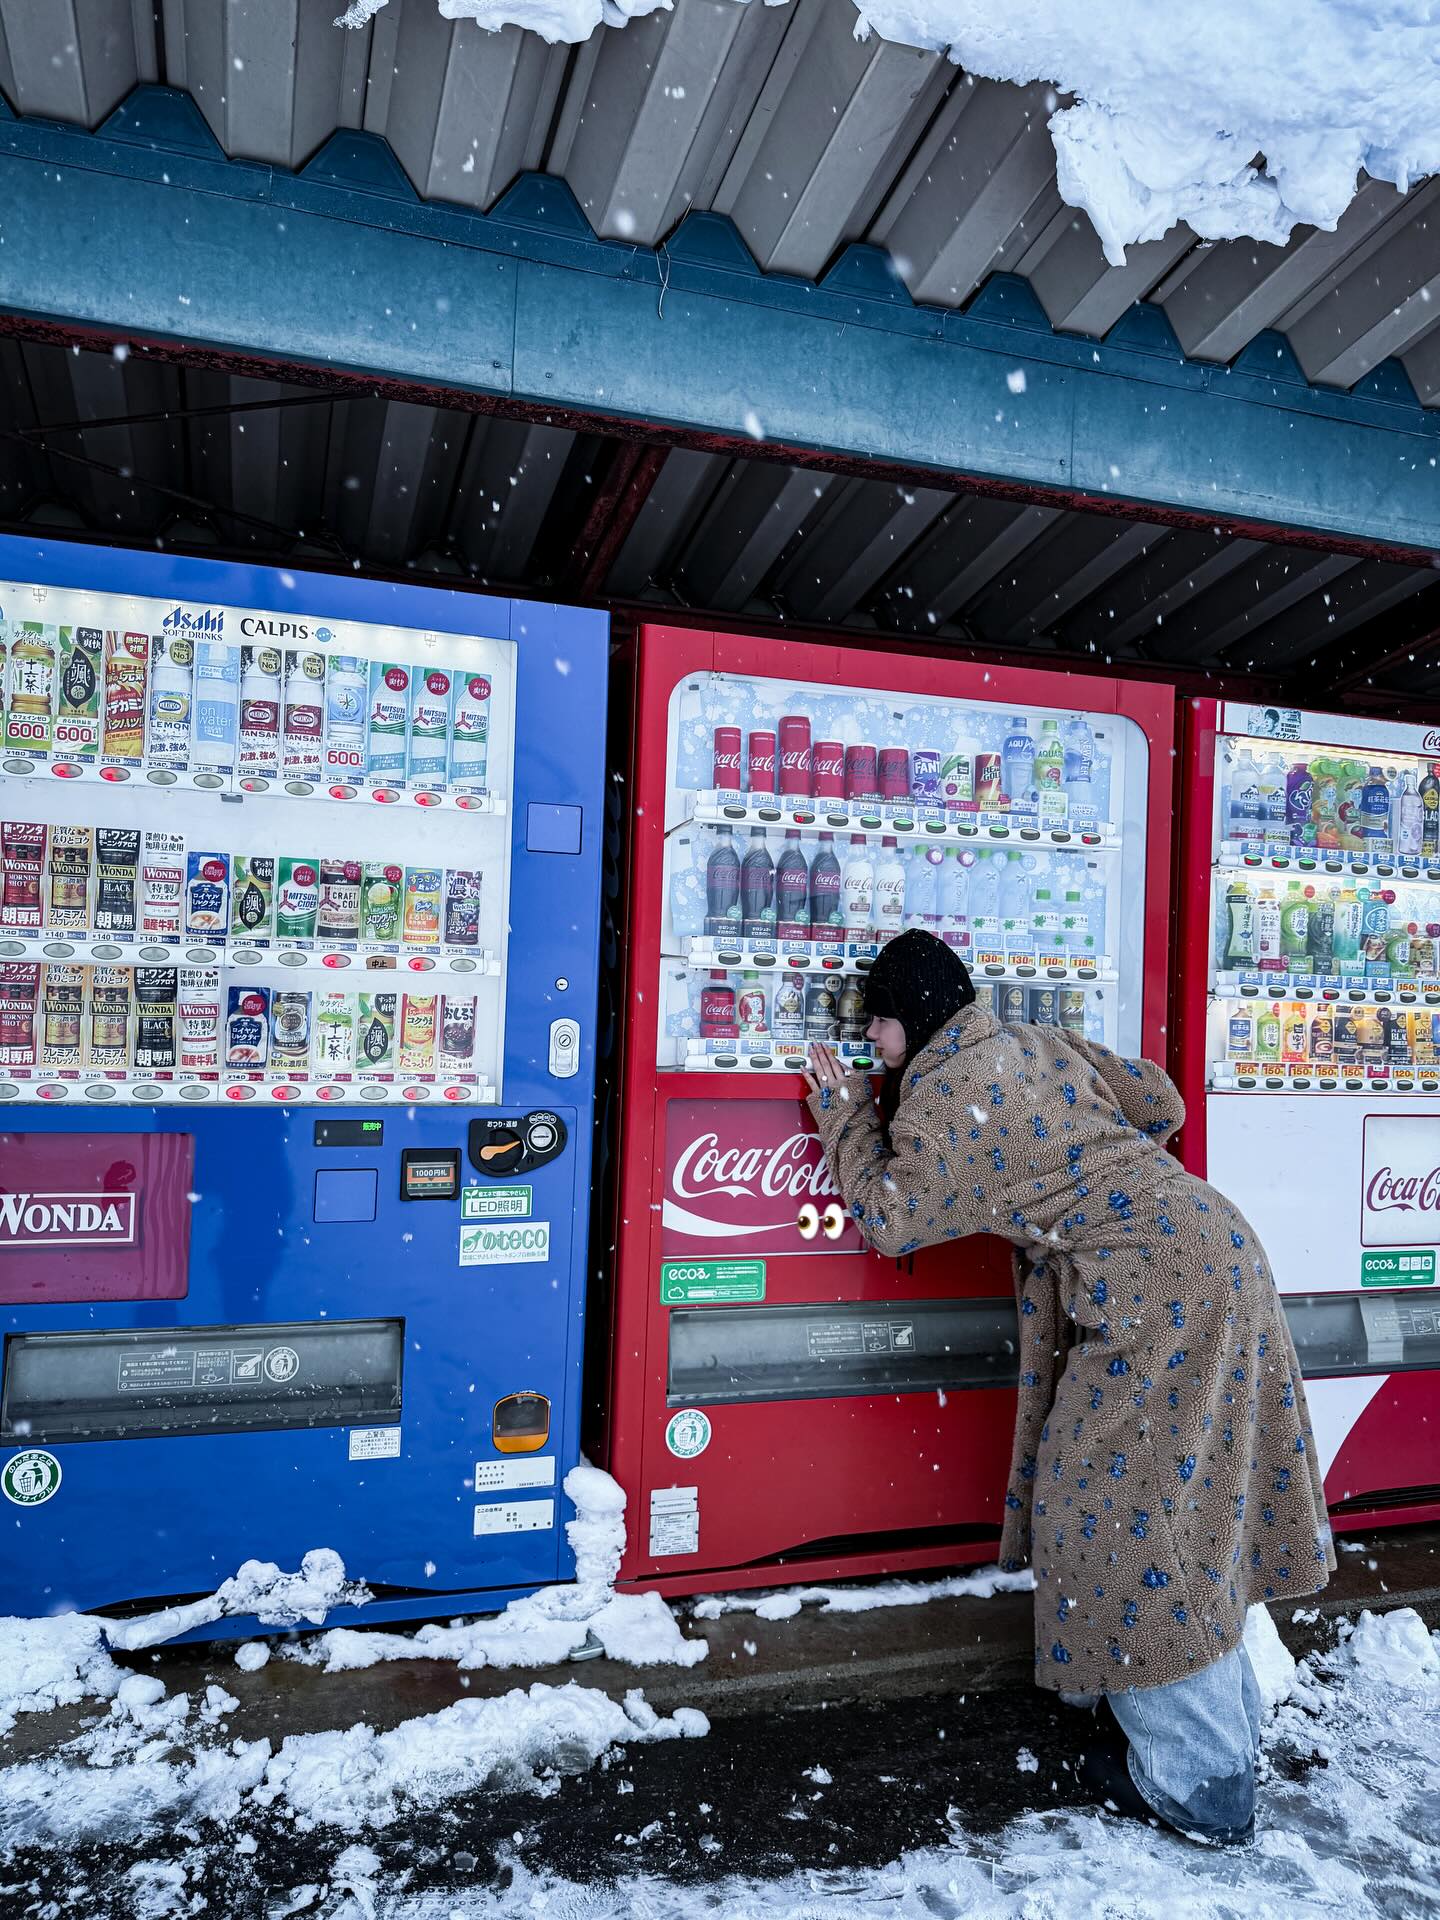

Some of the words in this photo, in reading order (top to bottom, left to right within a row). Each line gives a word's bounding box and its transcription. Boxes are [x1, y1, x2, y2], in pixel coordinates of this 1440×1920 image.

[162, 607, 224, 633] Asahi
[240, 618, 308, 639] CALPIS
[80, 630, 102, 640] すっきり
[162, 629, 187, 637] SOFT
[188, 631, 223, 642] DRINKS
[83, 638, 102, 650] 爽快
[173, 652, 190, 660] No.1
[262, 661, 278, 670] No.1
[306, 666, 321, 675] No.1
[24, 658, 40, 694] 十六茶
[201, 706, 215, 715] on
[150, 721, 189, 731] LEMON
[241, 730, 278, 738] TANSAN
[285, 734, 322, 743] TANSAN
[327, 750, 360, 766] 600
[53, 825, 76, 836] 上質な
[3, 833, 43, 841] モーニングアロマ
[52, 835, 90, 845] 香りとコク
[145, 832, 168, 841] 深煎り
[98, 839, 138, 848] モーニングアロマ
[145, 841, 184, 852] 珈琲豆使用
[5, 859, 40, 872] WONDA
[51, 861, 87, 875] WONDA
[253, 860, 273, 868] すっきり
[99, 865, 134, 877] WONDA
[146, 867, 180, 880] WONDA
[408, 874, 437, 884] すっきり
[103, 883, 131, 892] BLACK
[151, 882, 175, 894] 特製
[2, 906, 40, 925] 朝専用
[50, 908, 87, 919] プレミアム
[366, 913, 398, 924] メロンクリーム
[96, 910, 133, 929] 朝専用
[143, 917, 176, 931] 国産牛乳
[92, 932, 111, 940] ¥140
[140, 935, 158, 943] ¥140
[48, 964, 69, 974] 上質な
[371, 960, 388, 968] 中止
[94, 965, 116, 975] 上質な
[180, 969, 202, 978] 深煎り
[46, 973, 84, 983] 香りとコク
[93, 975, 130, 985] 香りとコク
[180, 978, 219, 987] 珈琲豆使用
[0, 1001, 33, 1011] WONDA
[46, 1000, 81, 1012] WONDA
[92, 1002, 127, 1013] WONDA
[137, 1003, 172, 1014] WONDA
[319, 999, 344, 1008] カラダに
[182, 1003, 216, 1015] WONDA
[327, 1007, 353, 1015] いいこと
[142, 1021, 170, 1029] BLACK
[188, 1019, 211, 1030] 特製
[327, 1021, 343, 1061] 十六茶
[43, 1047, 80, 1057] プレミアム
[91, 1049, 127, 1058] プレミアム
[136, 1048, 173, 1067] 朝専用
[181, 1054, 214, 1066] 国産牛乳
[415, 1168, 448, 1177] 1000円札
[470, 1199, 523, 1213] LED照明
[0, 1193, 124, 1235] WONDA
[14, 1484, 53, 1502] リサイクル
